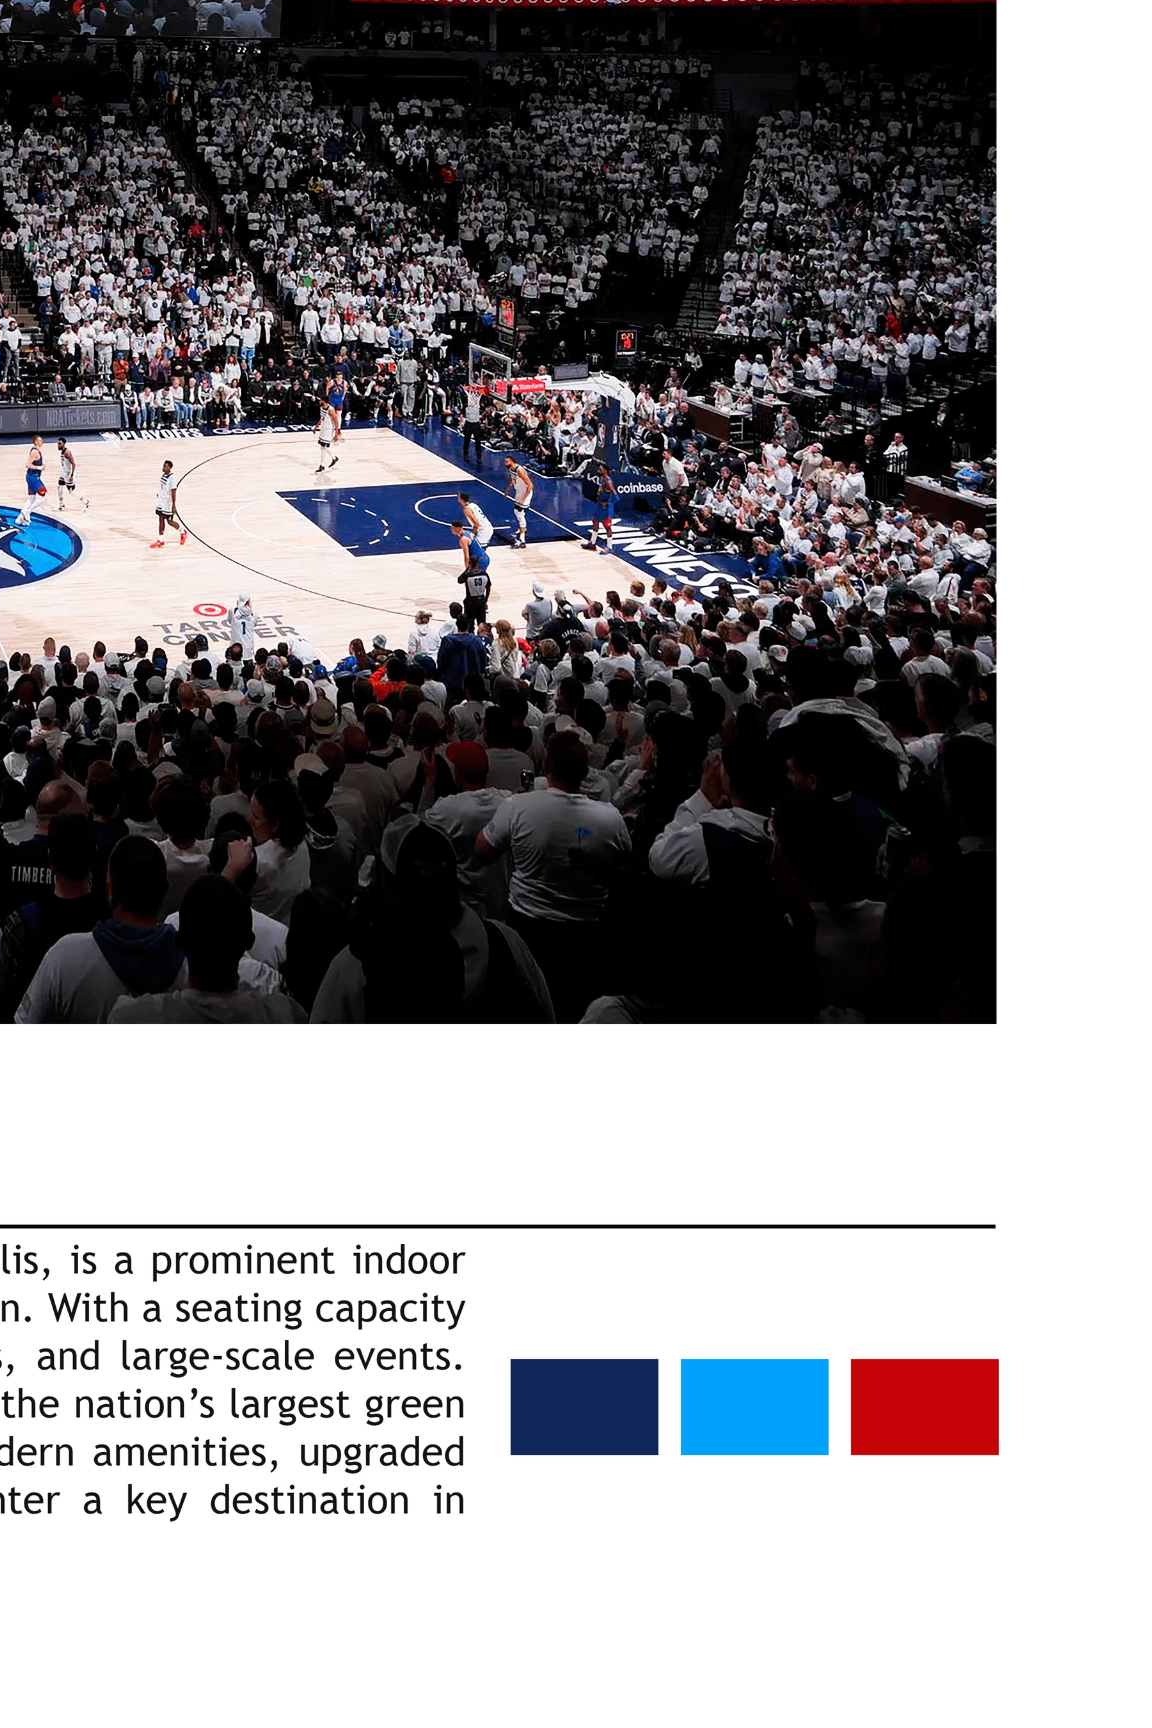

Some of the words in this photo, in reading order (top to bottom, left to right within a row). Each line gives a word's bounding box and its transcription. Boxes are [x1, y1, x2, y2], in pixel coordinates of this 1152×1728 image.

[47, 406, 121, 427] NBATickets.com
[118, 427, 203, 441] PLAYOFFS
[212, 425, 288, 435] Google
[617, 482, 664, 494] coinbase
[574, 518, 759, 598] MINNESO
[162, 626, 300, 645] CENER
